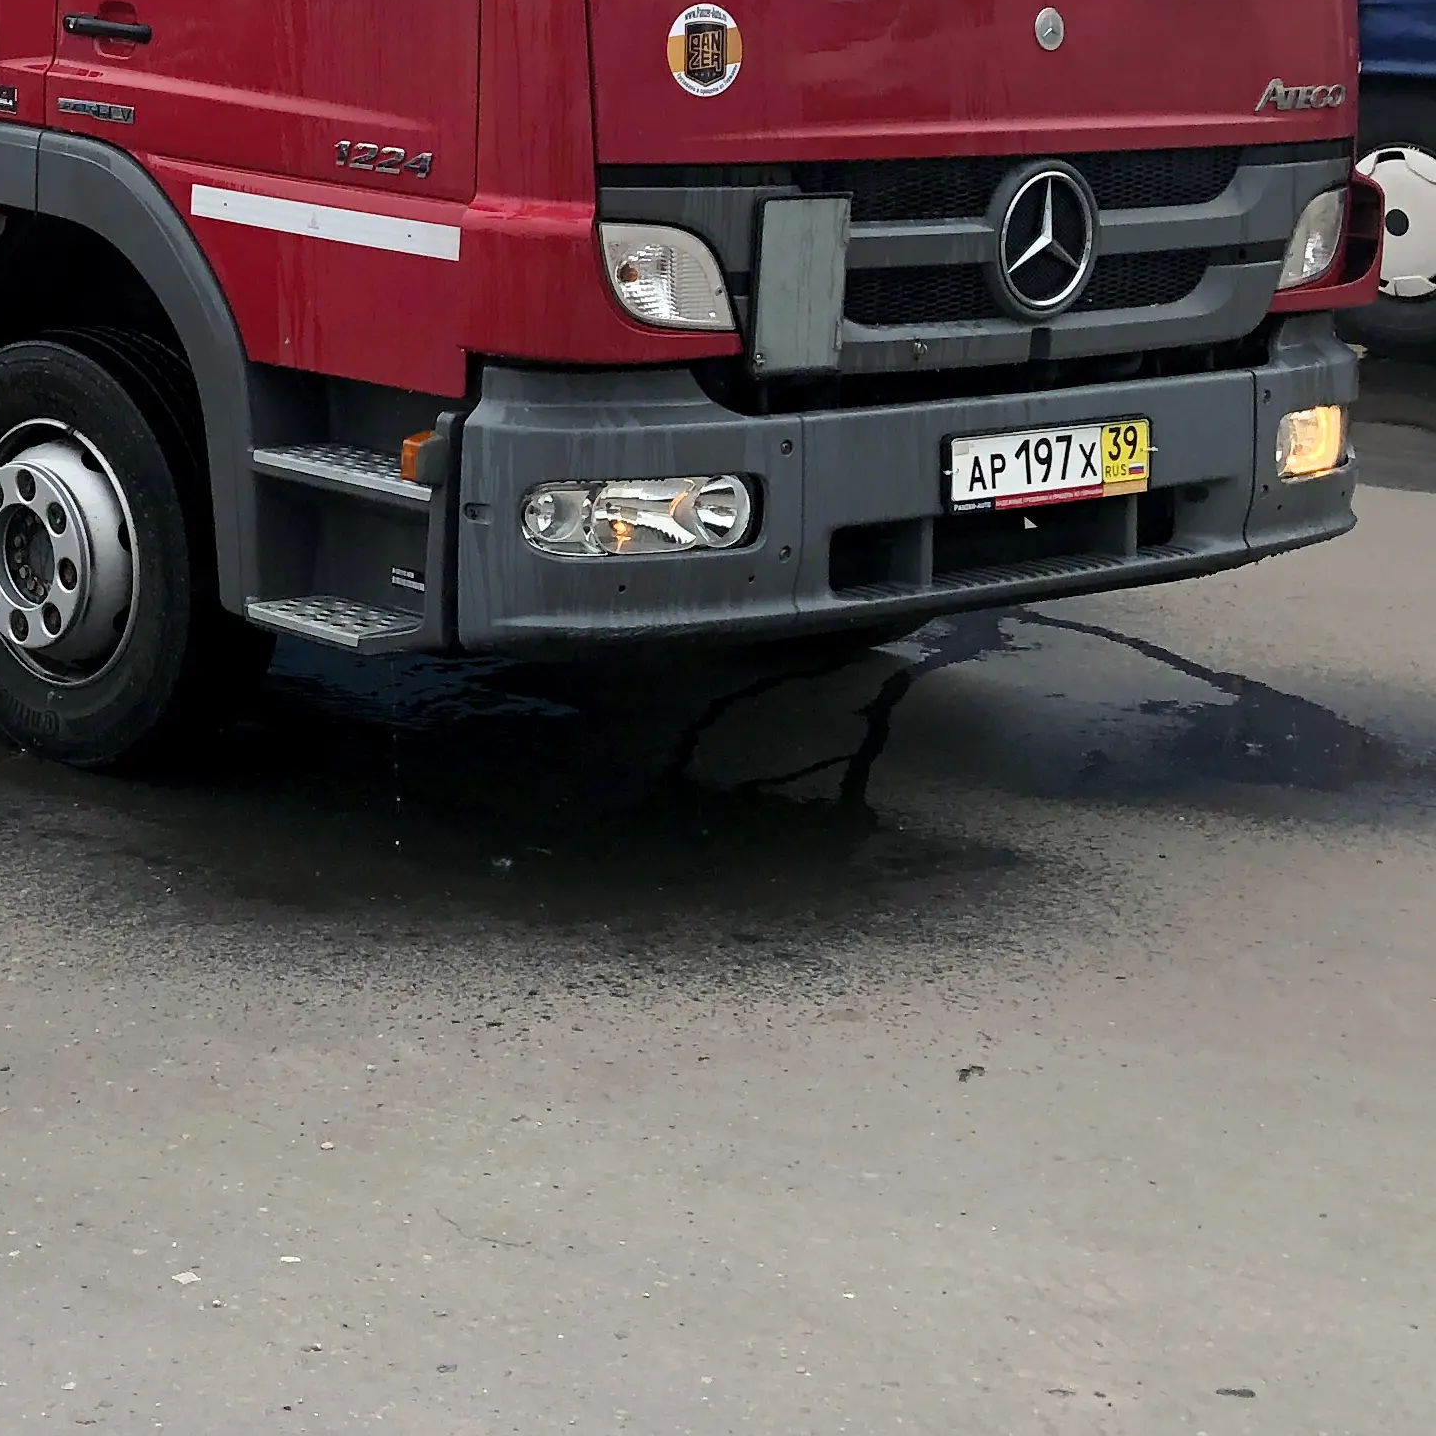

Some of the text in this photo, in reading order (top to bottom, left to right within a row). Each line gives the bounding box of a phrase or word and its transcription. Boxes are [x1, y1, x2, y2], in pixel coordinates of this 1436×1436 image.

[333, 140, 433, 179] 1224
[1108, 425, 1138, 461] 39
[1105, 463, 1127, 478] RUS
